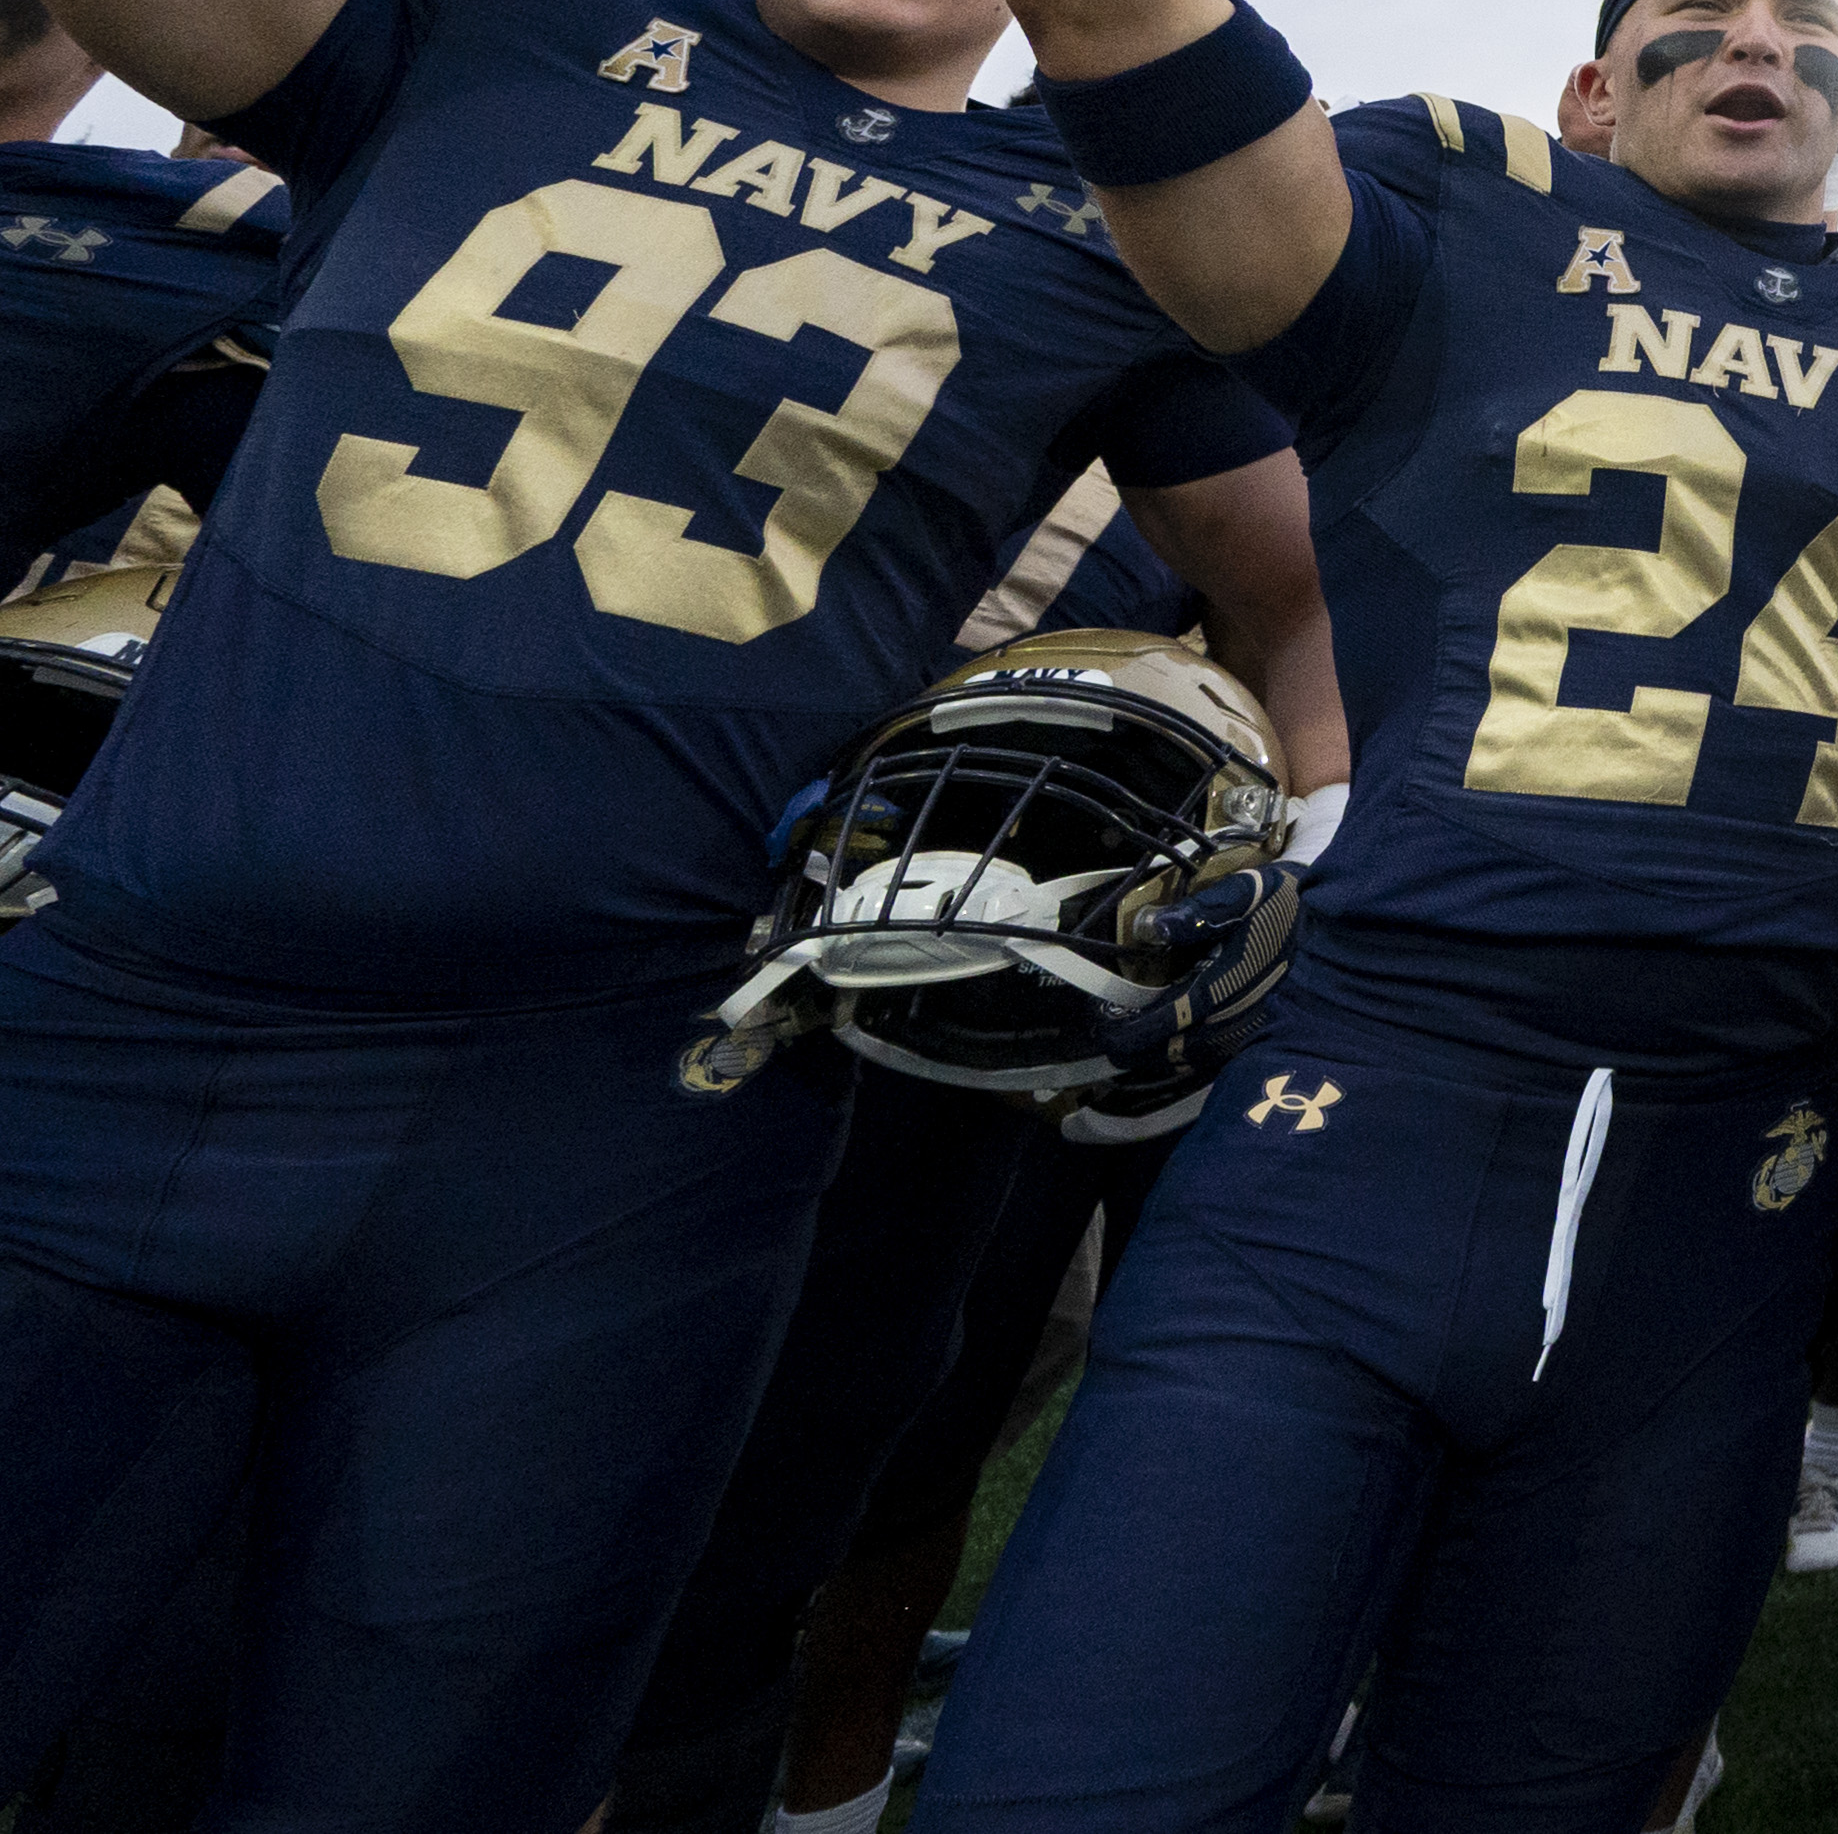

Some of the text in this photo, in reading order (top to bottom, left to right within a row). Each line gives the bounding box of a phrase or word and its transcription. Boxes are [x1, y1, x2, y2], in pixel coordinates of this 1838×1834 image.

[599, 18, 702, 93] A
[592, 102, 995, 273] NAVY
[1556, 226, 1641, 294] A
[316, 179, 961, 644] 93
